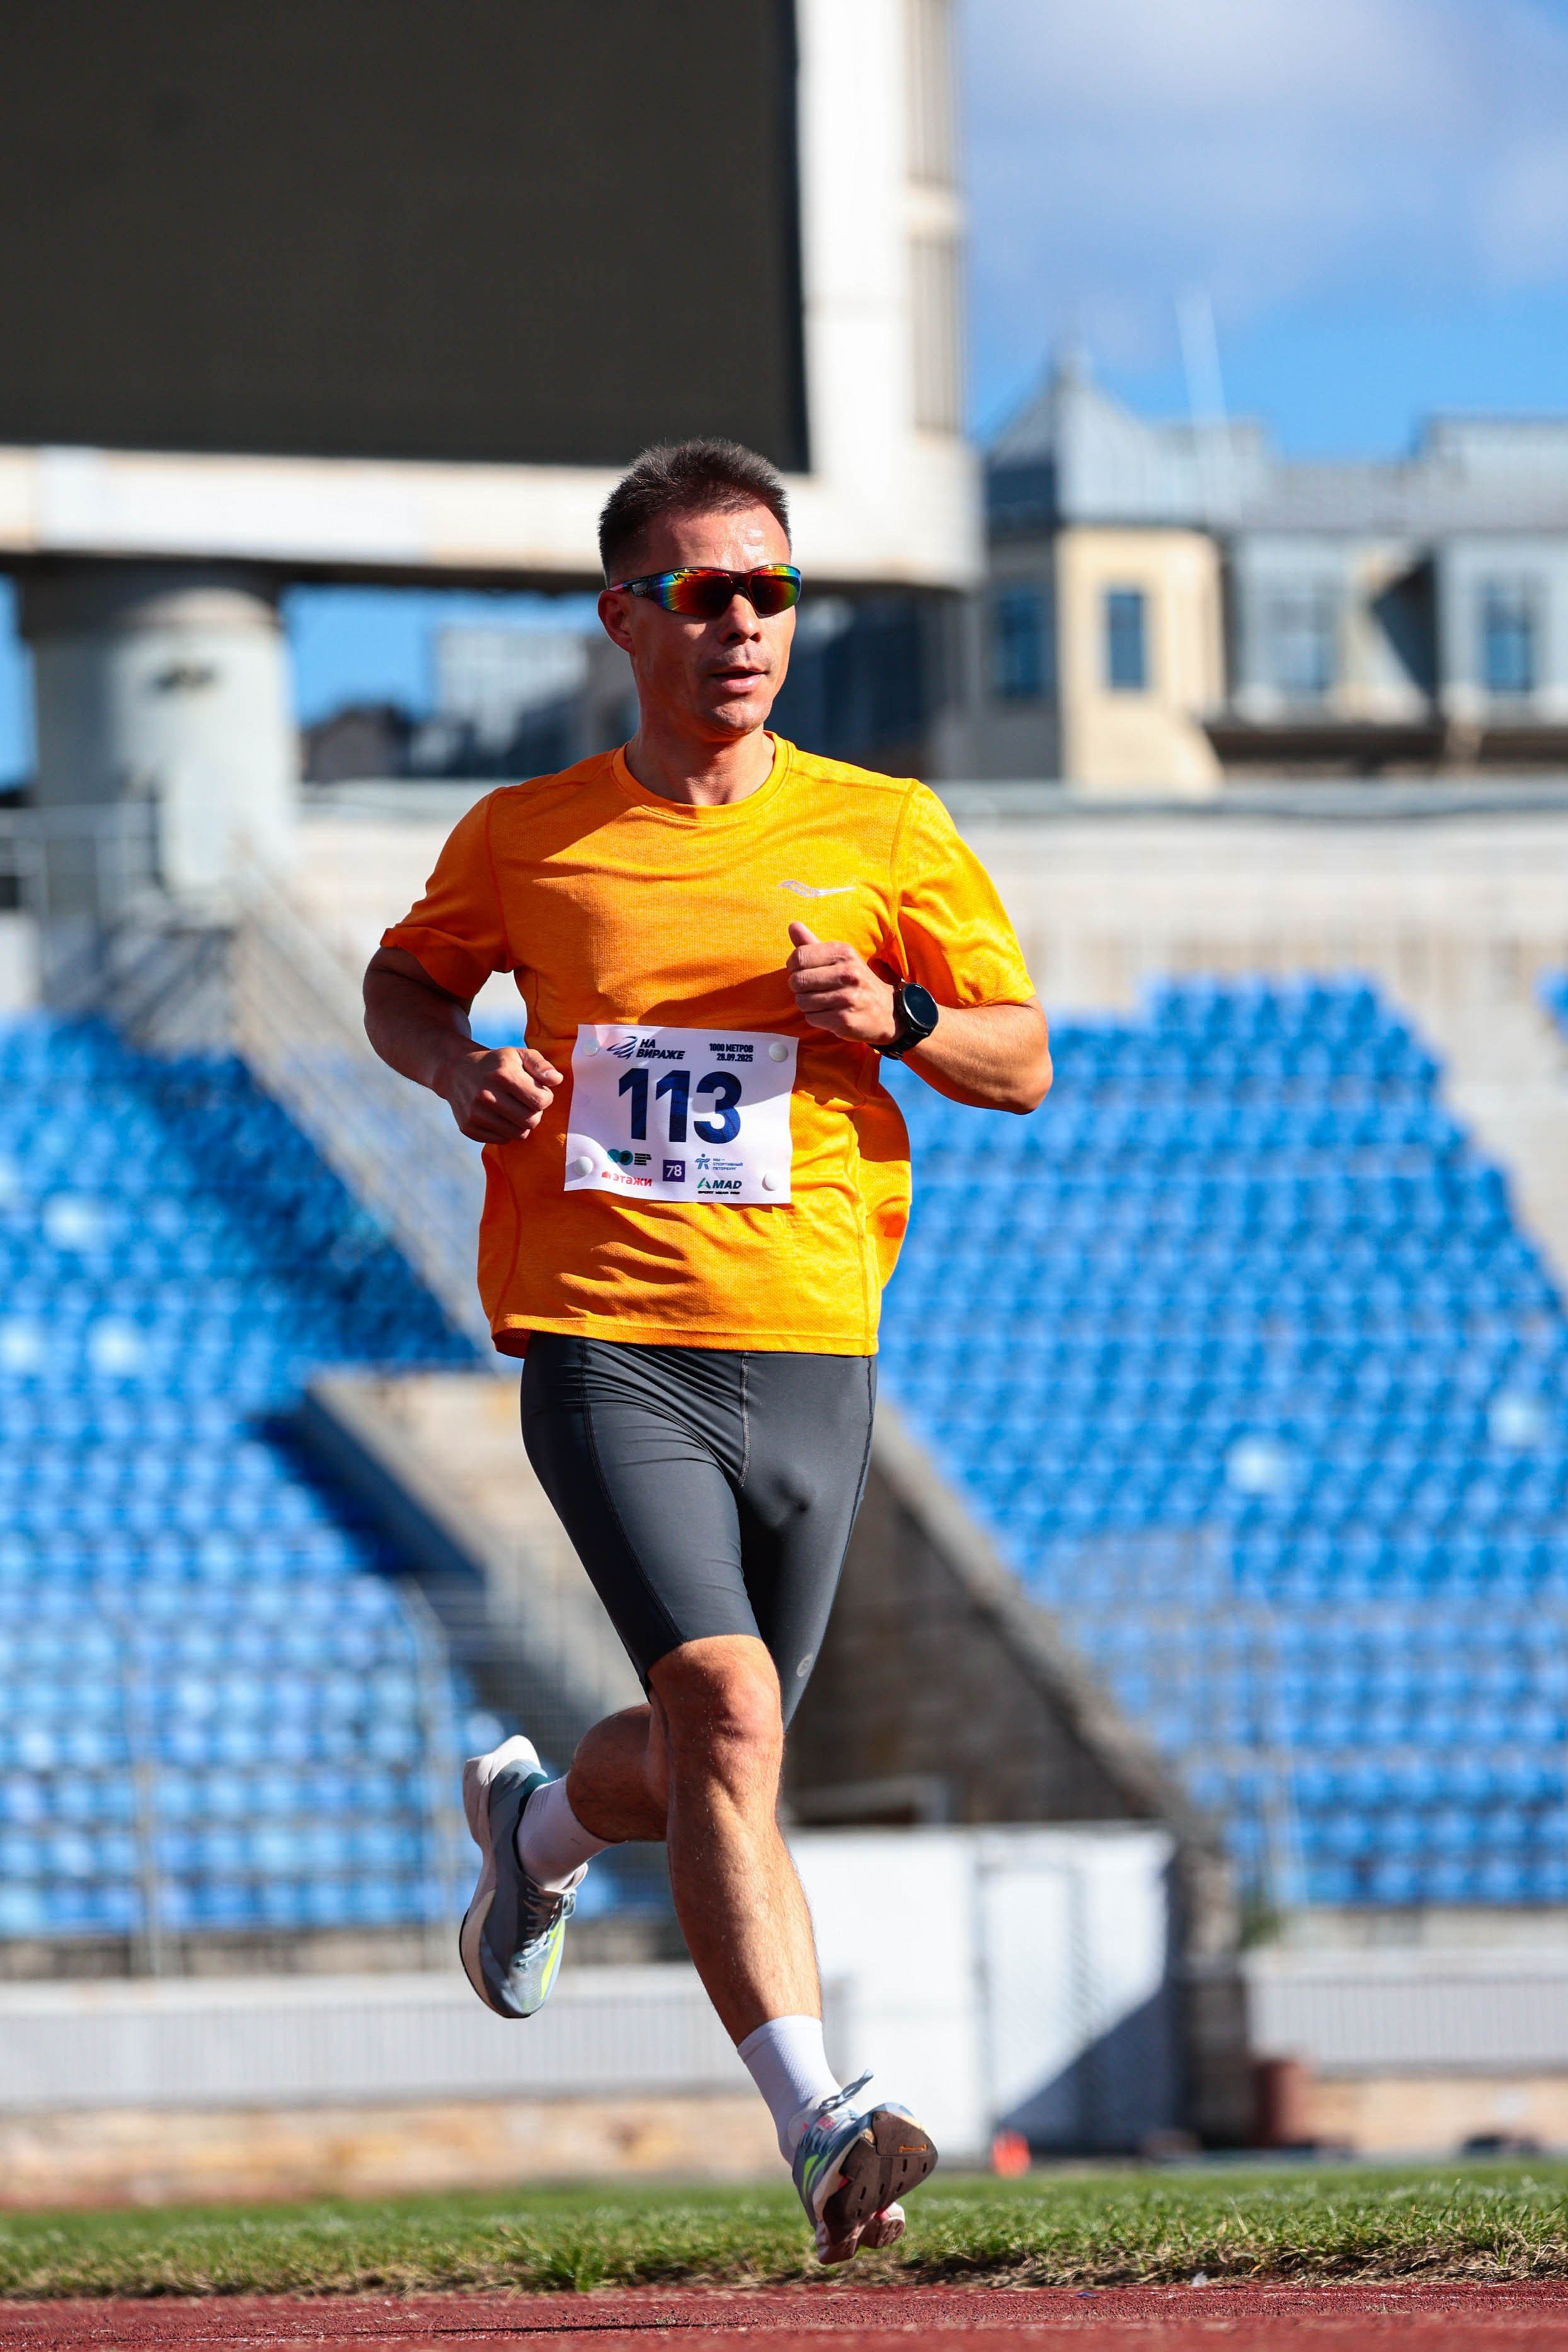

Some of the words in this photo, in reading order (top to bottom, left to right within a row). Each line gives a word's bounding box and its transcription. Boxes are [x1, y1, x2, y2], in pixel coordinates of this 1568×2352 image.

[639, 1039, 656, 1048] НА
[709, 1043, 724, 1052] 1000
[726, 1044, 753, 1053] МЕТРОВ
[636, 1048, 685, 1060] ВИРАЖЕ
[717, 1053, 753, 1062] 28.09.2025
[619, 1068, 742, 1144] 113
[666, 1165, 682, 1178] 78
